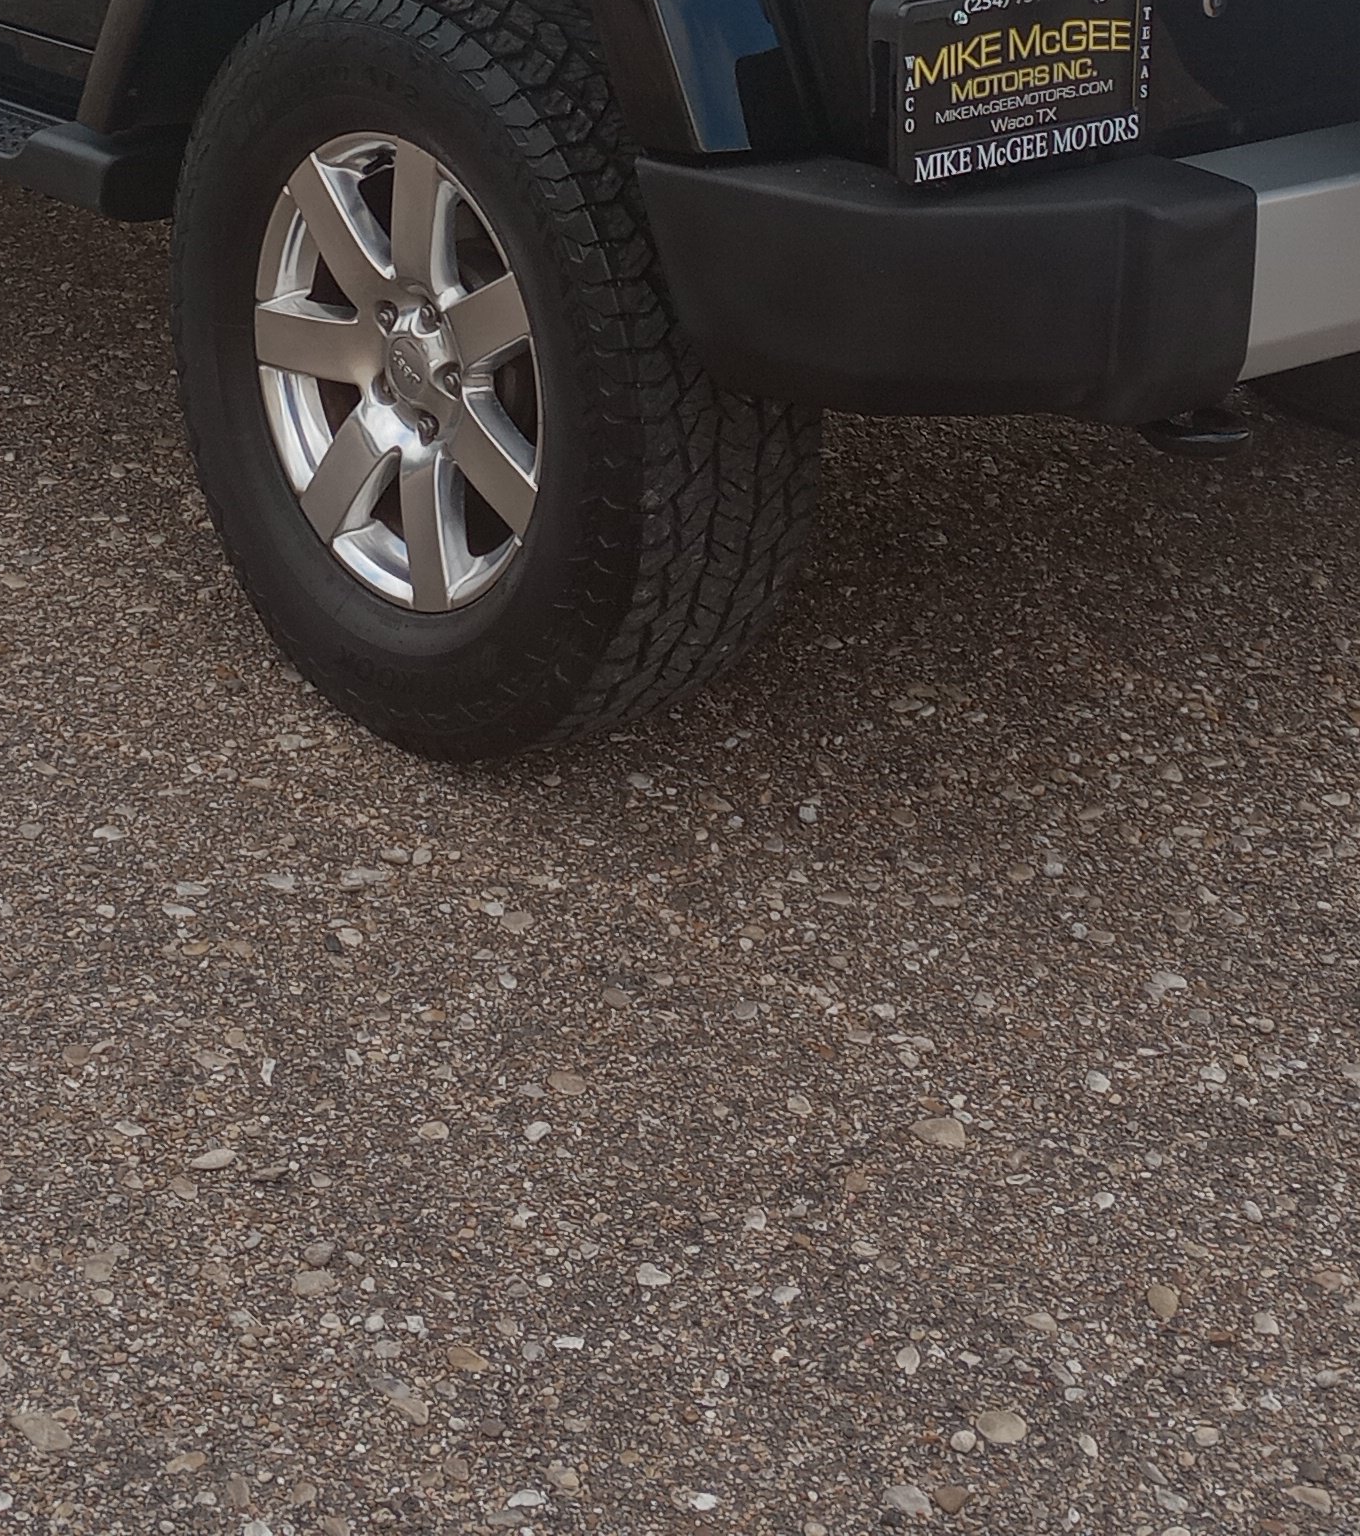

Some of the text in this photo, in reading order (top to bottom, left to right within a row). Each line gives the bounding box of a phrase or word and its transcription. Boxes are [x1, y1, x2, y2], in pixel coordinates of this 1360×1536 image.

[914, 19, 1131, 89] MIKE McGEE
[935, 79, 1113, 124] MIKEMcGEEMOTORS.COM
[951, 58, 1098, 104] MOTORS INC.
[990, 107, 1057, 133] Waco TX
[914, 114, 1139, 183] MIKE McGEE MOTORS
